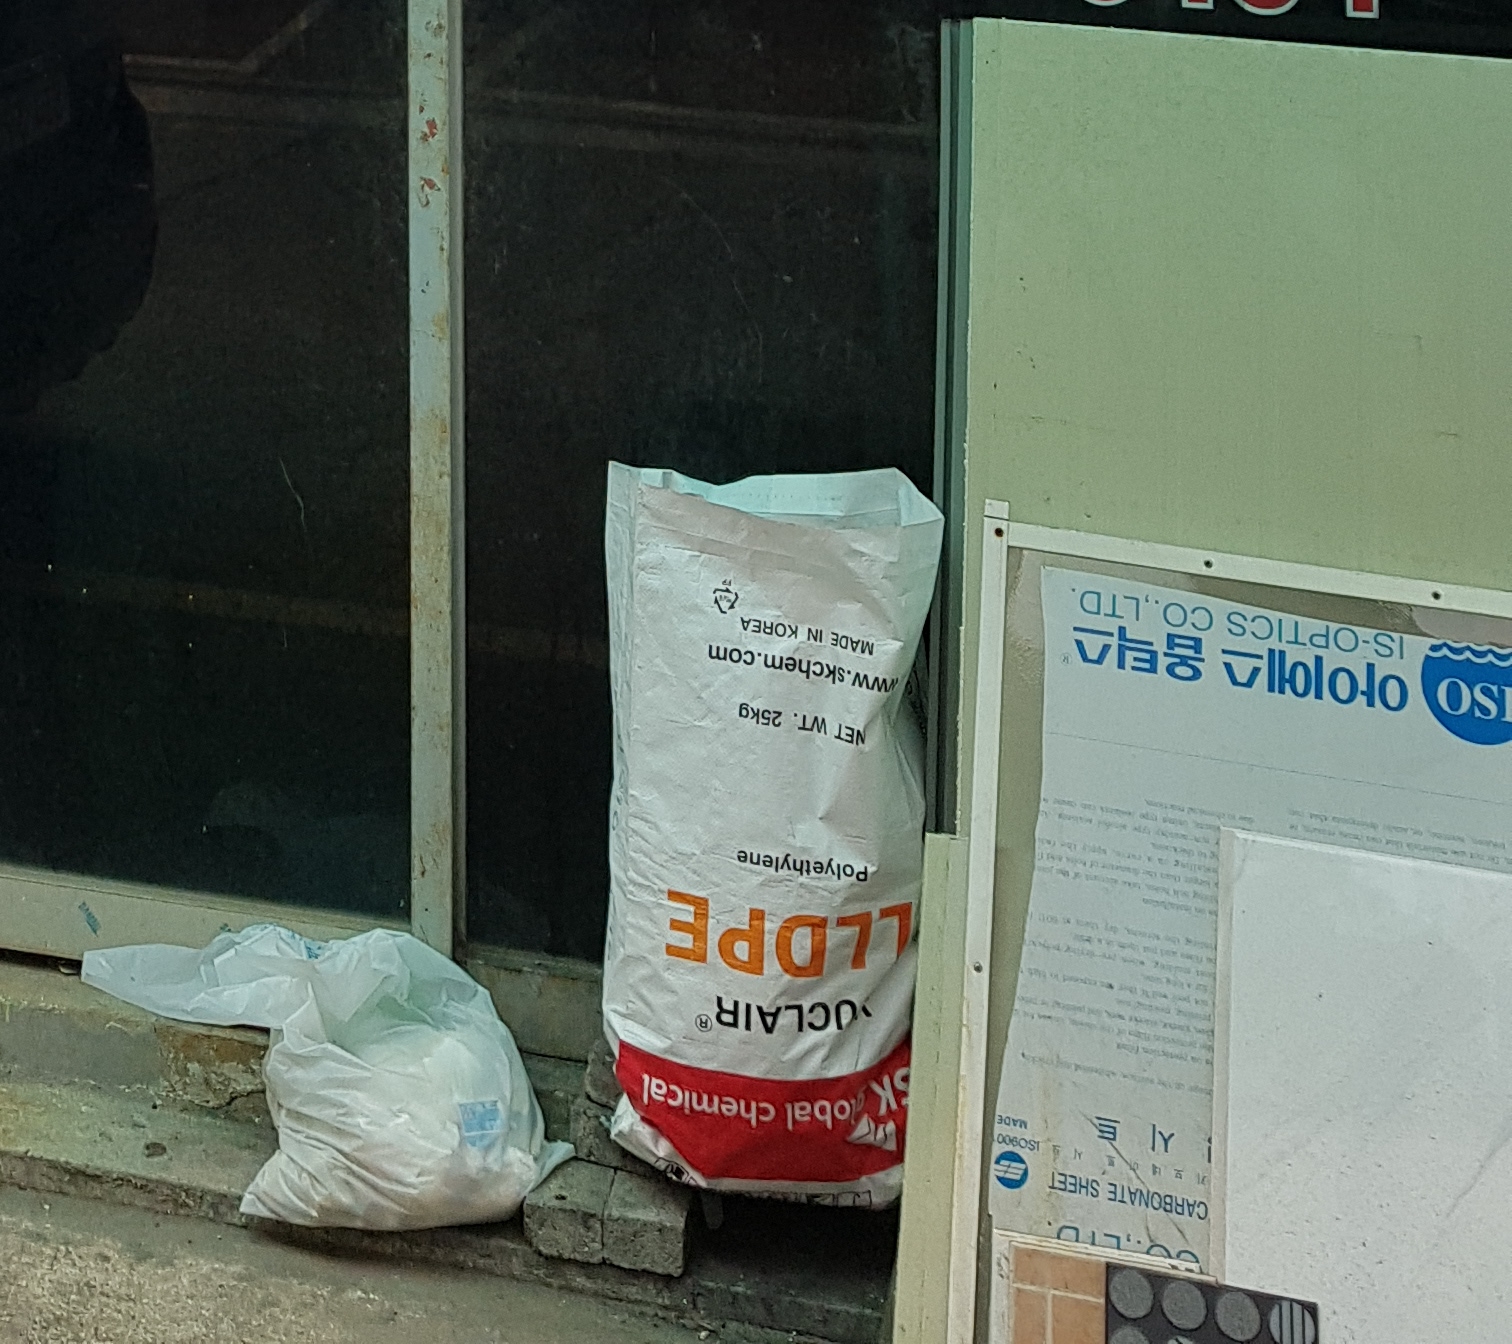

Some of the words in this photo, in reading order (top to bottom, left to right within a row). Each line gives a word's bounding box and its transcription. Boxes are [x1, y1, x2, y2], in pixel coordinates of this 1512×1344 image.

[1071, 588, 1213, 632] CO.,LTD.
[740, 617, 798, 639] KOREA
[807, 627, 823, 644] IN
[831, 632, 874, 656] MADE
[1226, 612, 1405, 660] IS-OPTICS
[708, 644, 899, 694] www.skchem.com
[1073, 626, 1206, 682] 옵틱스
[1221, 647, 1409, 713] 아이에스
[738, 704, 783, 727] 25kg
[793, 712, 826, 735] WT.
[834, 723, 866, 746] NET
[736, 850, 869, 882] Polyethylene
[664, 889, 913, 978] LLDPE
[642, 1072, 776, 1129] chemical
[1048, 1171, 1100, 1199] SHEET
[1107, 1182, 1209, 1220] CARBONATE
